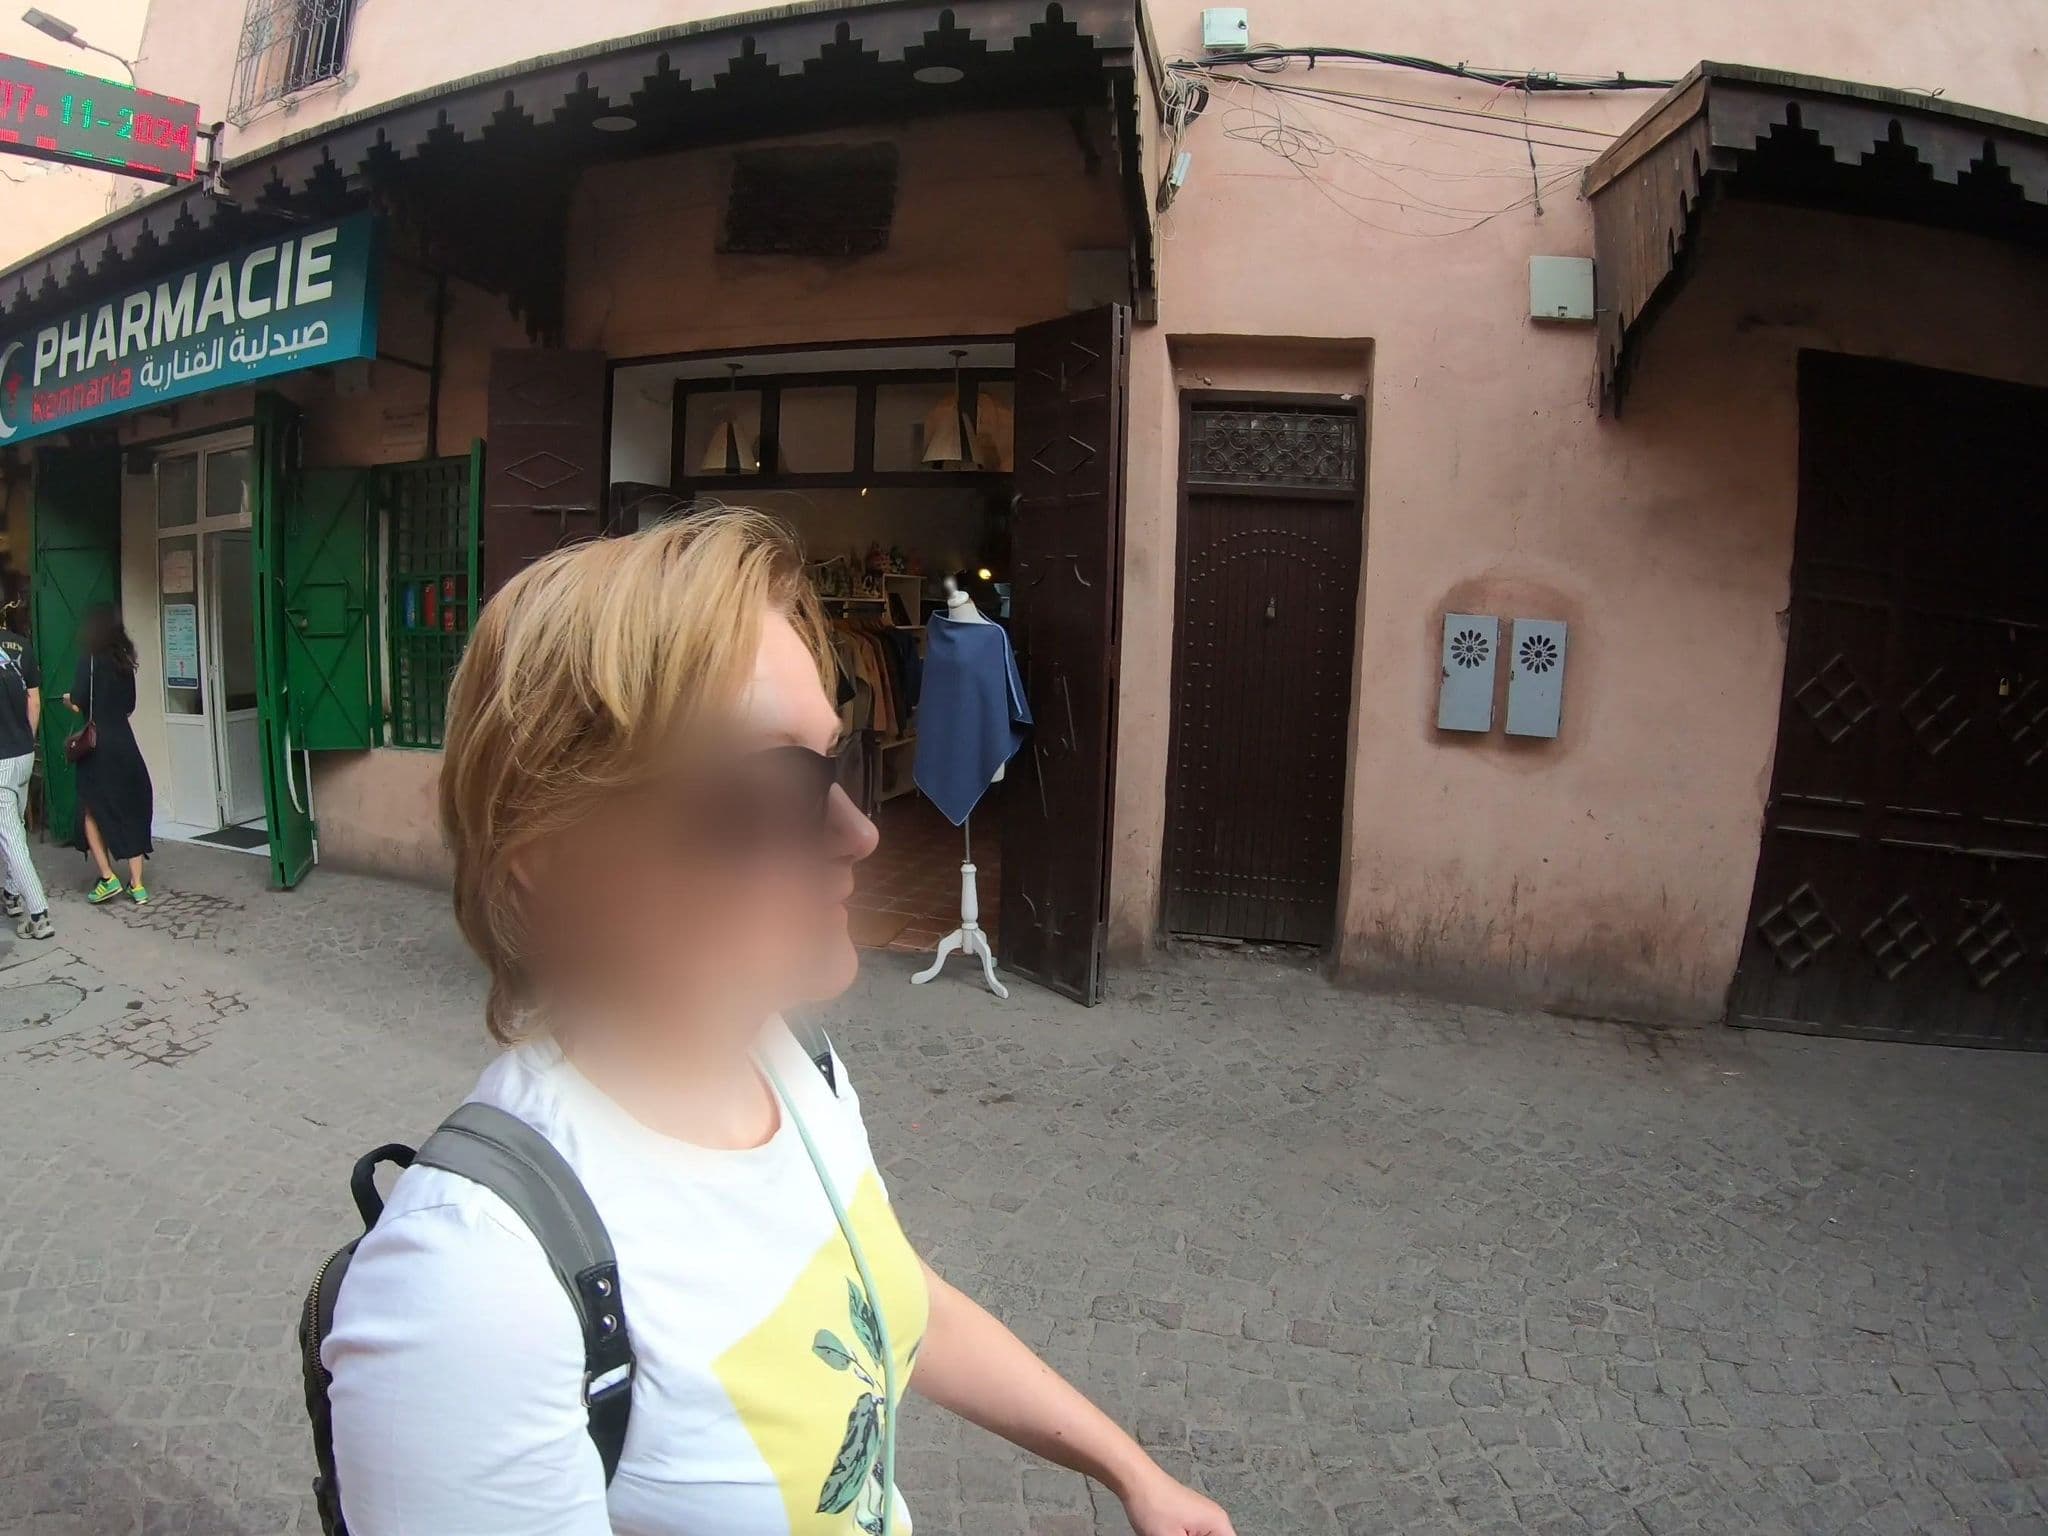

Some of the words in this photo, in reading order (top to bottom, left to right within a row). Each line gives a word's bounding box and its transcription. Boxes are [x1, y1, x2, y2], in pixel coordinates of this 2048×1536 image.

[33, 227, 338, 387] PHARMACIE
[140, 336, 224, 392] القنارية
[229, 320, 328, 369] صيدلية
